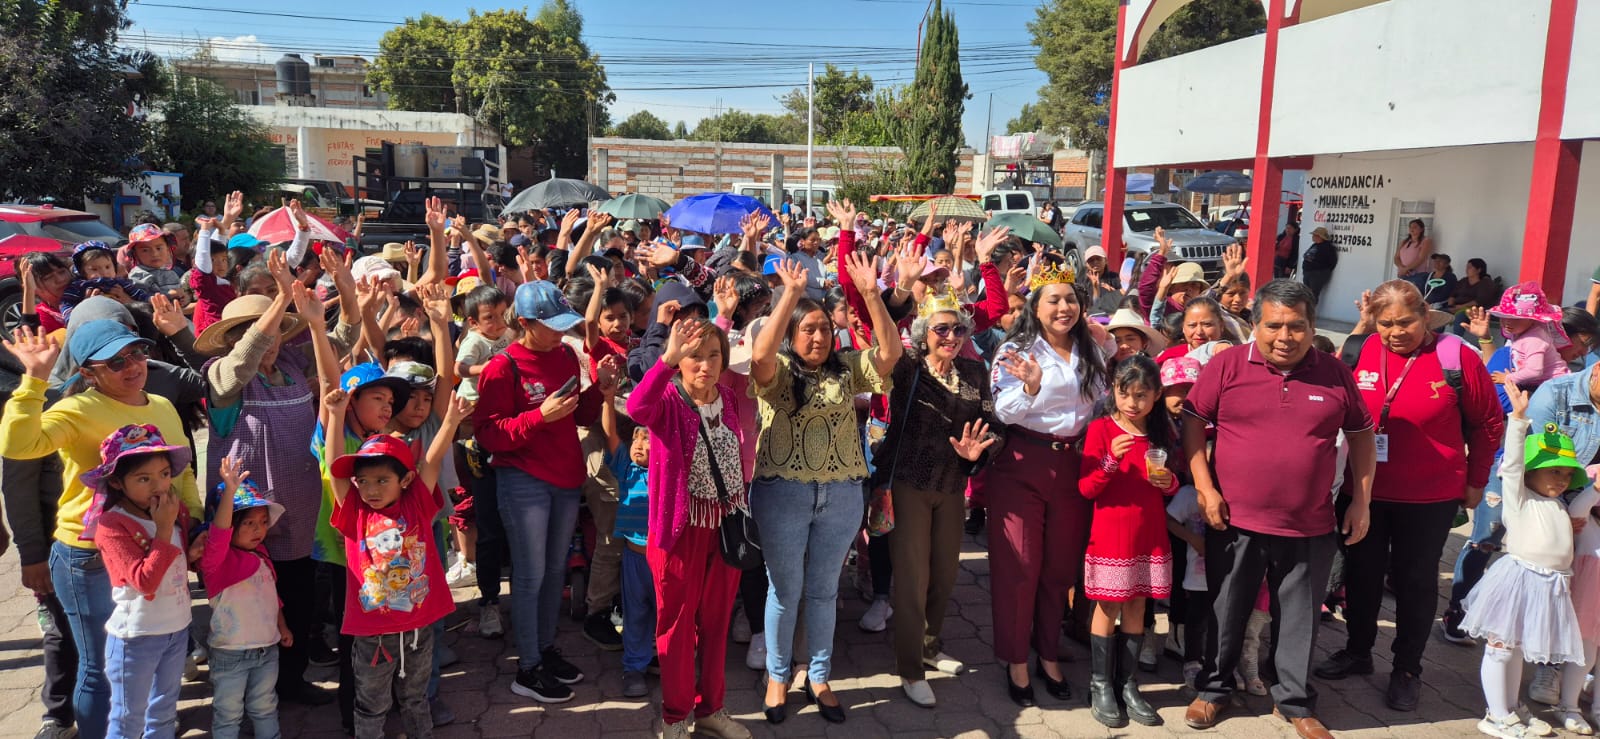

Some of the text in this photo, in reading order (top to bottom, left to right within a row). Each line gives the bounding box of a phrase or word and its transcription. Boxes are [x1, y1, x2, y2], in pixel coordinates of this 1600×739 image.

[1310, 174, 1384, 189] COMANDANCIA
[1319, 195, 1370, 208] MUNICIPAL
[1326, 213, 1375, 224] 2223290623
[1329, 233, 1372, 246] 222470562
